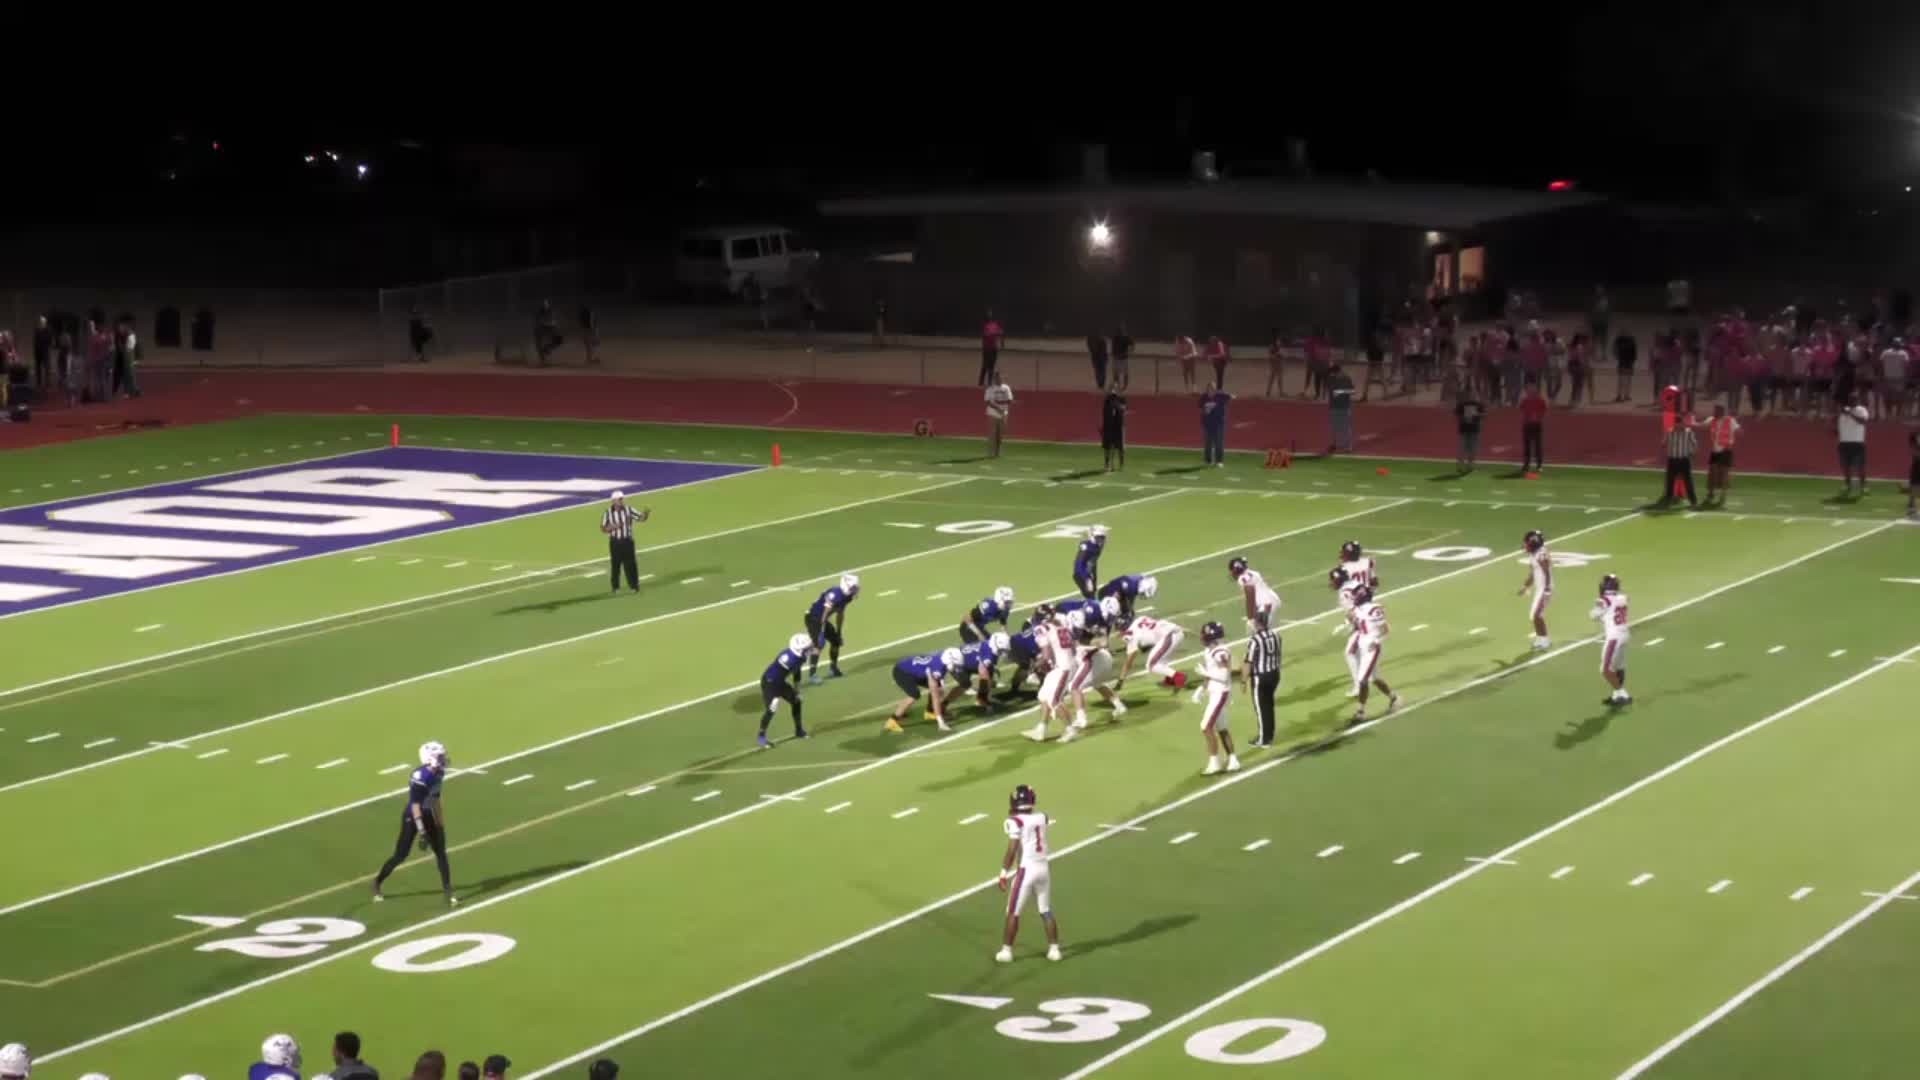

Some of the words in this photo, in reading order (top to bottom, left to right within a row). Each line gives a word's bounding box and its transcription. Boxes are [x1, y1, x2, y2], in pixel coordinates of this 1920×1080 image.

[0, 467, 641, 602] NOR
[1034, 825, 1043, 853] 1
[194, 917, 516, 973] 20
[995, 997, 1327, 1064] 30
